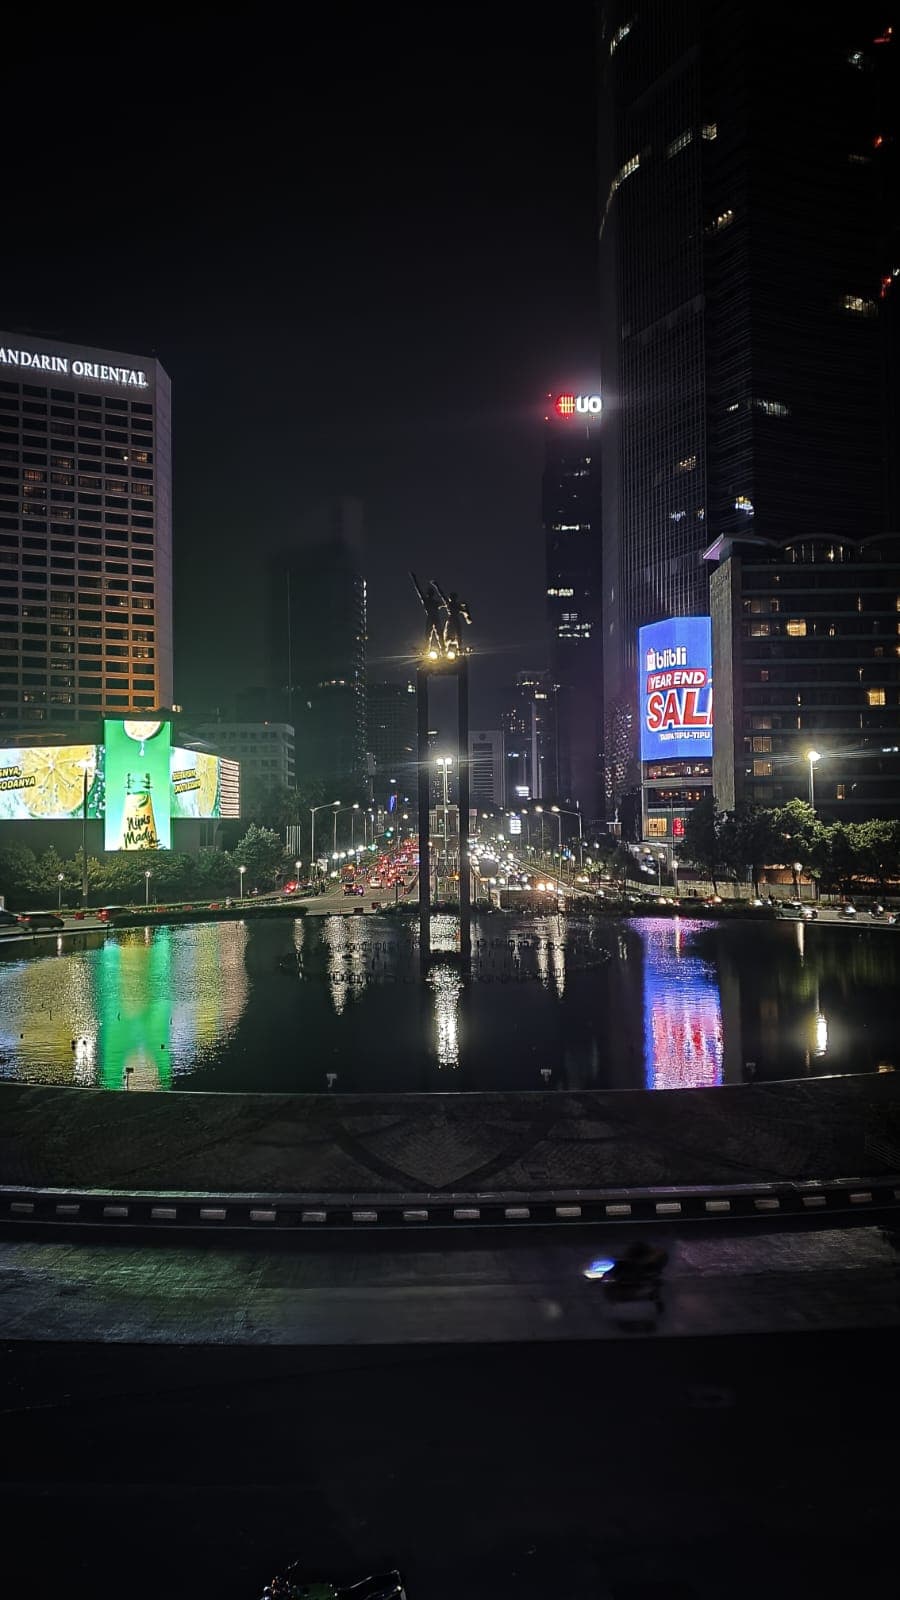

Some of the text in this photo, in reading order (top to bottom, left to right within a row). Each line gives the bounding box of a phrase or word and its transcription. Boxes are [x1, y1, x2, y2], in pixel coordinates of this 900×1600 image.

[0, 347, 147, 385] ANDARIN ORIENTAL
[656, 647, 687, 669] blibli
[650, 671, 705, 690] YEAR END
[647, 688, 713, 732] SAL
